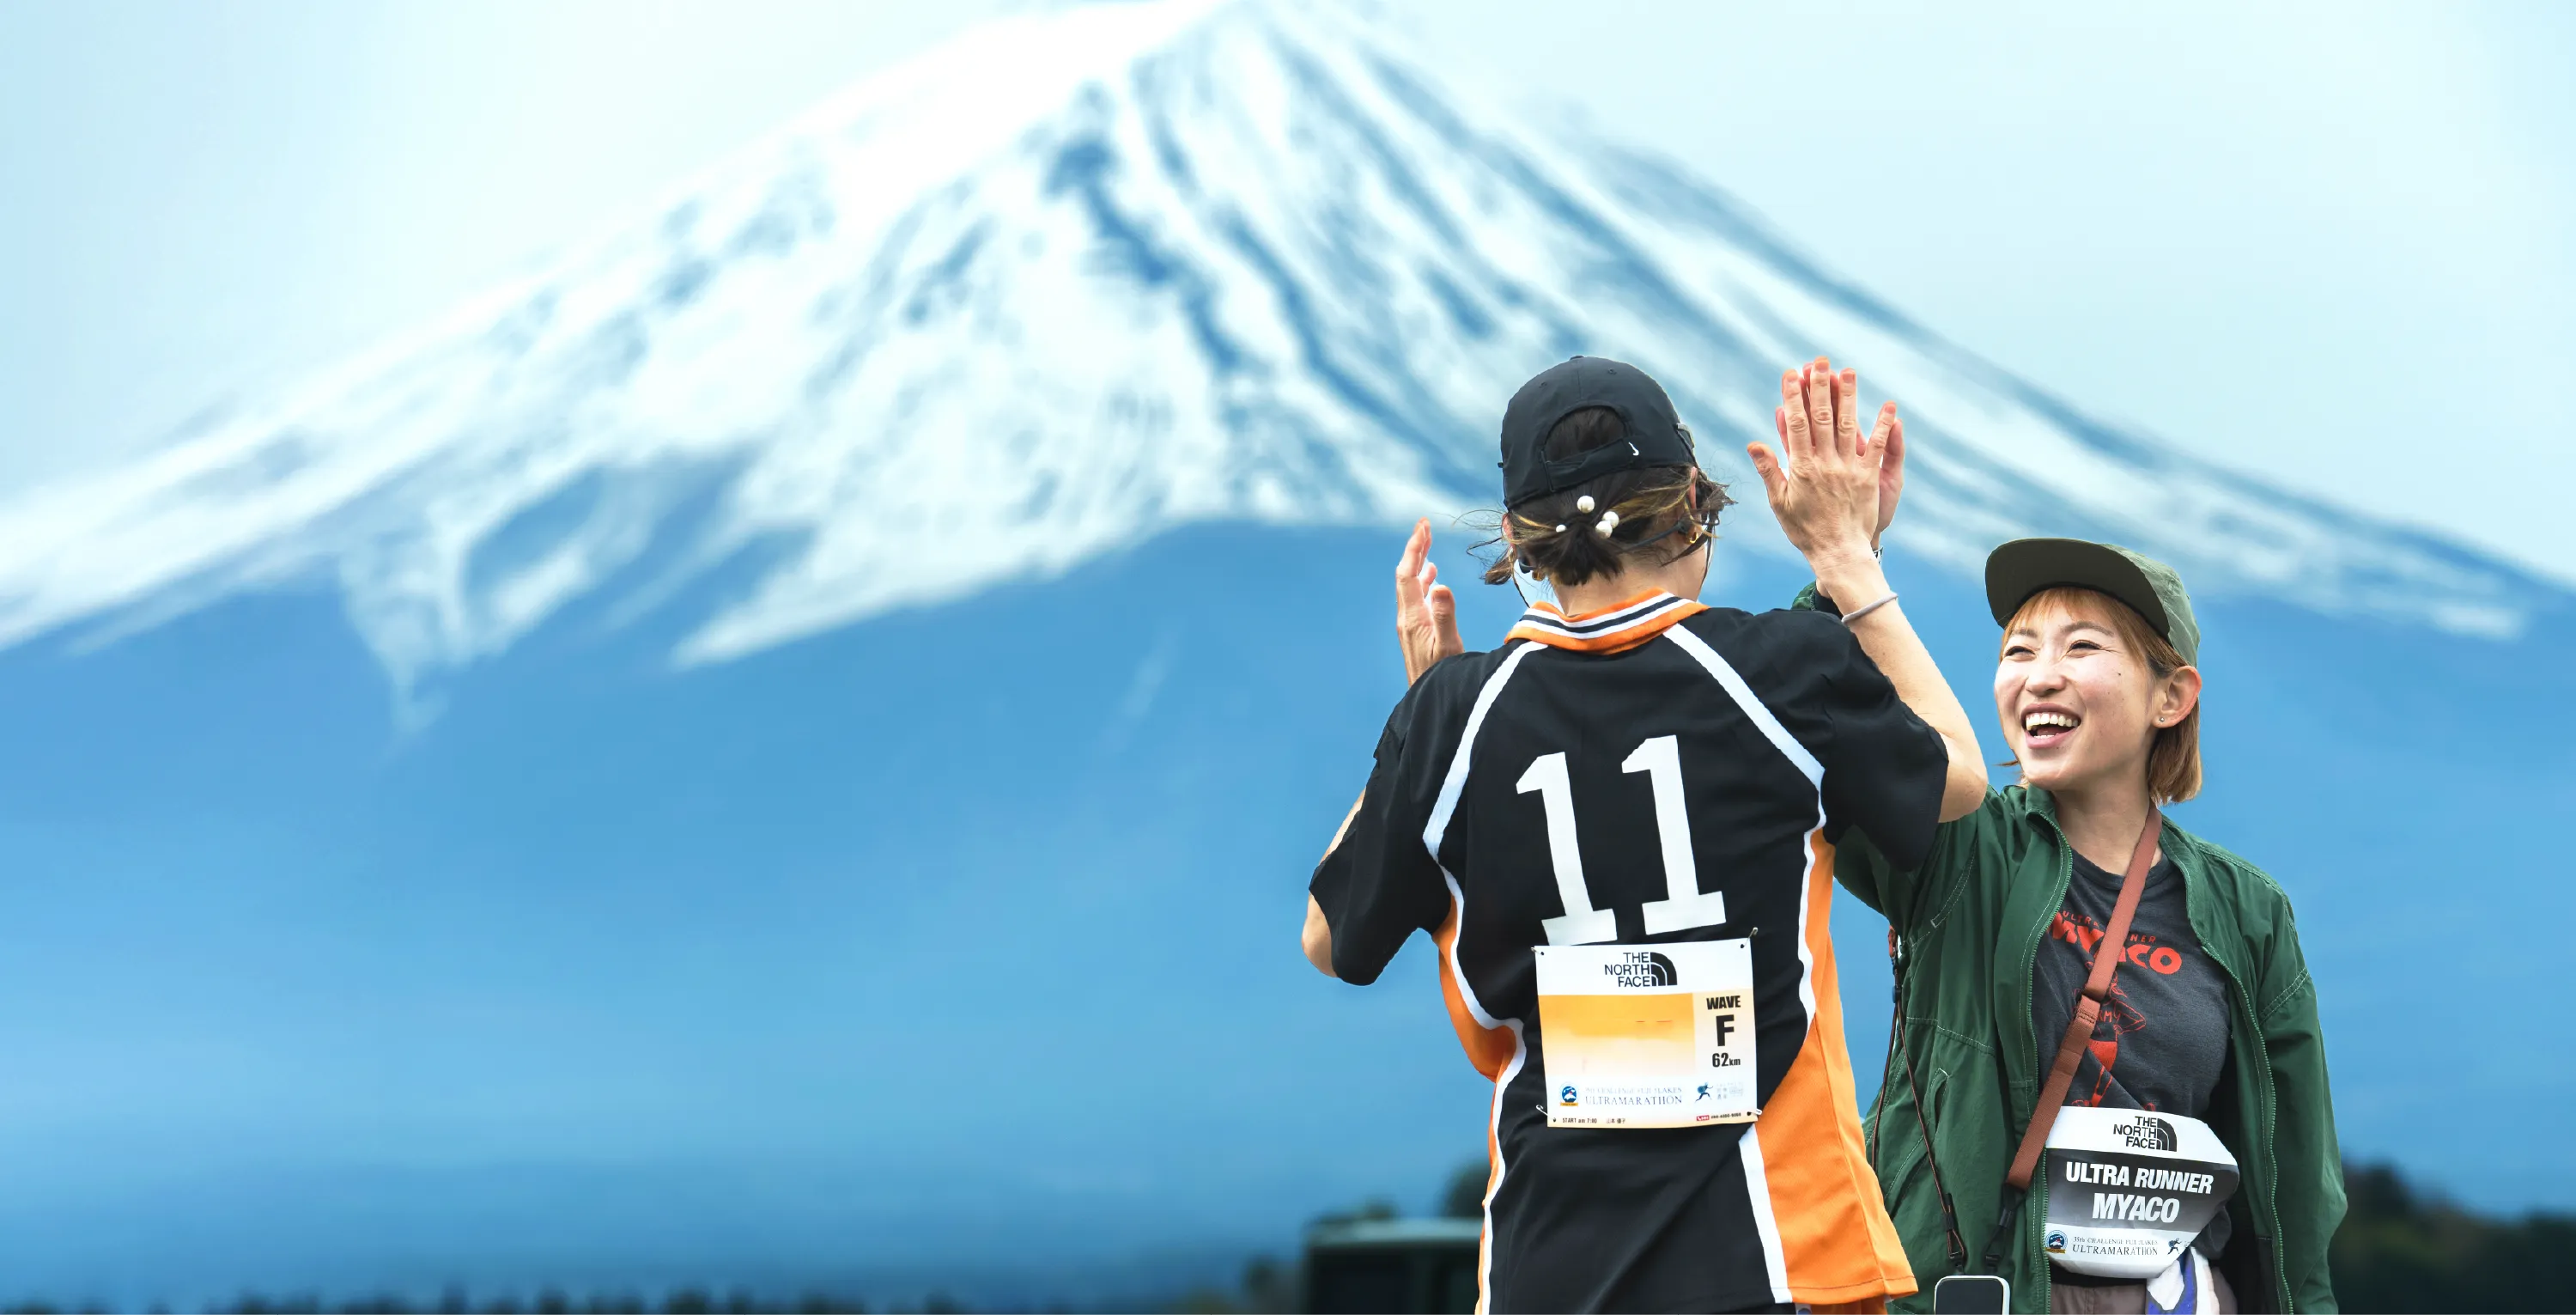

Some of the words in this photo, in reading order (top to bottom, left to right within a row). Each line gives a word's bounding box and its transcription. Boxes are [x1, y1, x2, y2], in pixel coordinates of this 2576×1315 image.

[1516, 734, 1726, 946] 11
[2063, 910, 2099, 928] ULTRA
[1623, 952, 1649, 963] THE
[1604, 964, 1650, 976] NORTH
[1618, 976, 1650, 987] FACE
[1706, 995, 1741, 1010] WAVE
[1716, 1014, 1735, 1046] F
[1712, 1052, 1741, 1067] 62km
[1585, 1095, 1682, 1105] ULTRAMARATHON
[2135, 1116, 2157, 1128] THE
[2113, 1123, 2156, 1138] NORTH
[2125, 1136, 2156, 1149] FACE
[2066, 1161, 2129, 1186] ULTRA
[2135, 1167, 2214, 1194] RUNNER
[2092, 1193, 2180, 1223] MYACO
[2072, 1245, 2158, 1256] ULTRAMARATHON
